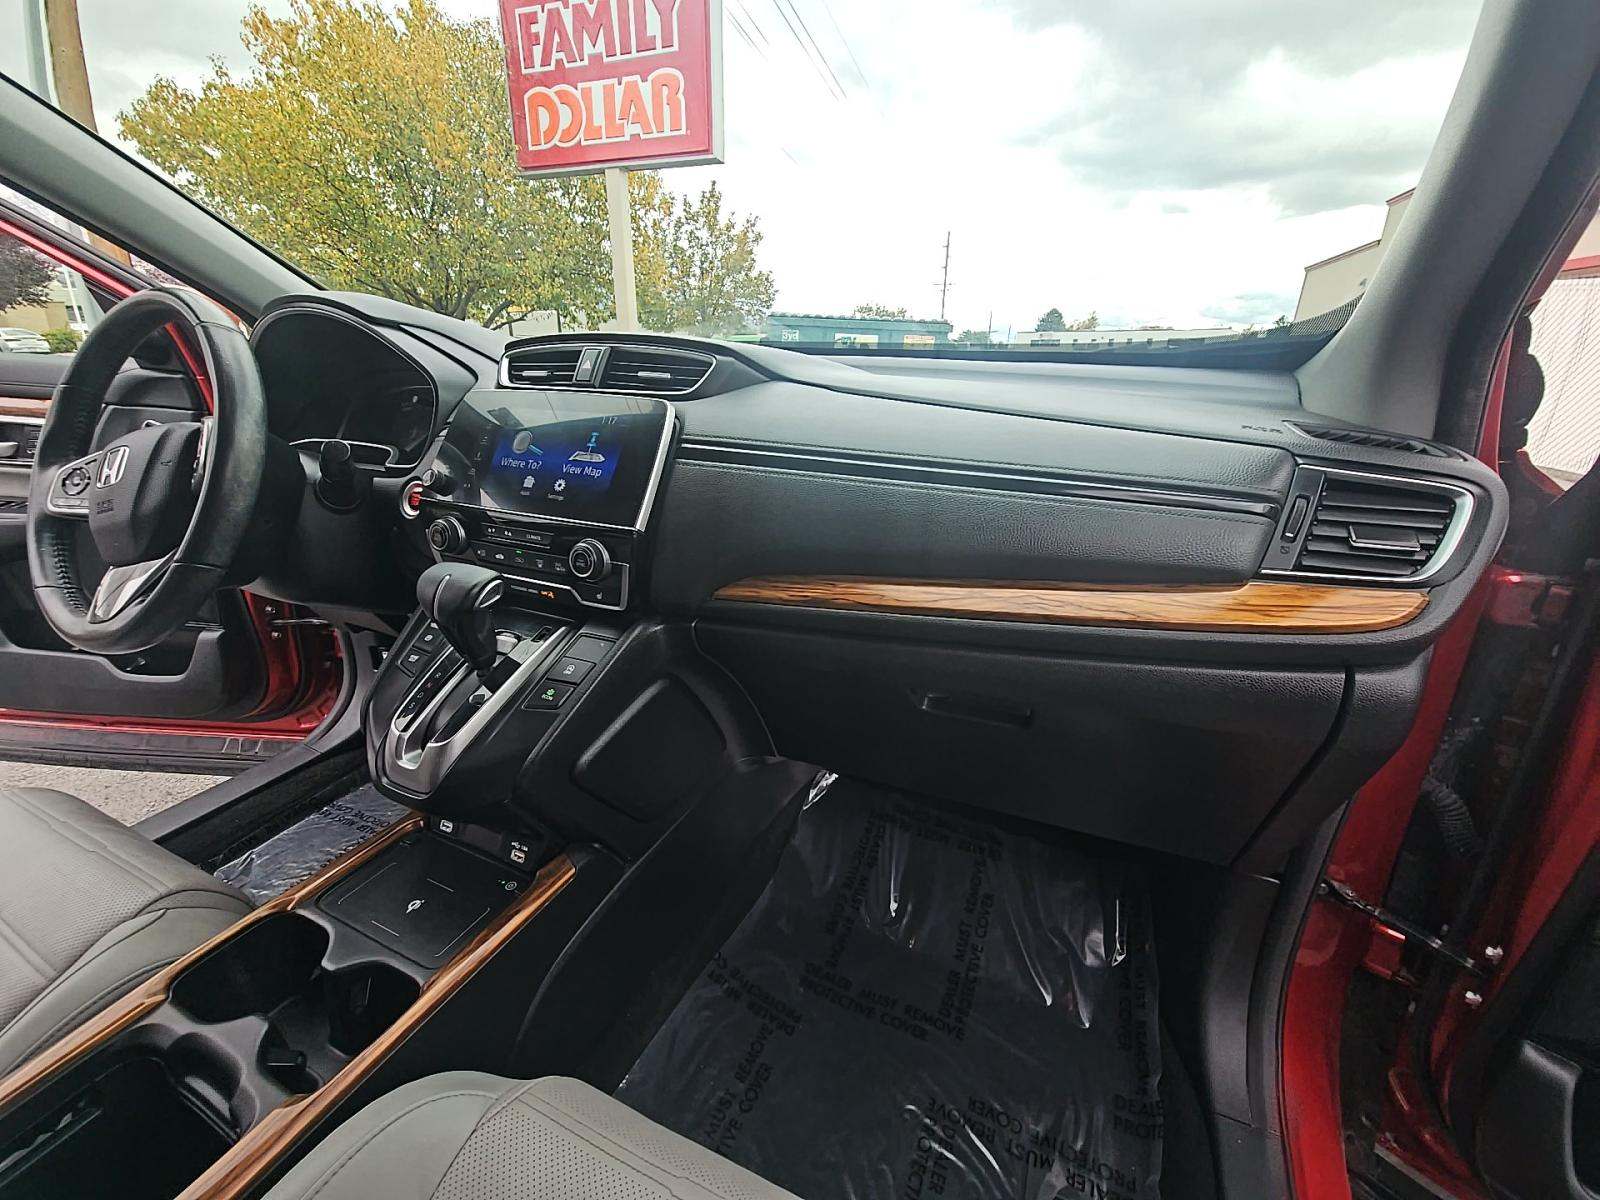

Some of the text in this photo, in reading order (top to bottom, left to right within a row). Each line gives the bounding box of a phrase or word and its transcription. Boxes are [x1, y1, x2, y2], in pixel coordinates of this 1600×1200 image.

[515, 0, 679, 75] FAMILY
[524, 68, 686, 151] DOLLAR
[501, 457, 542, 470] Where To?
[562, 464, 602, 478] View Map
